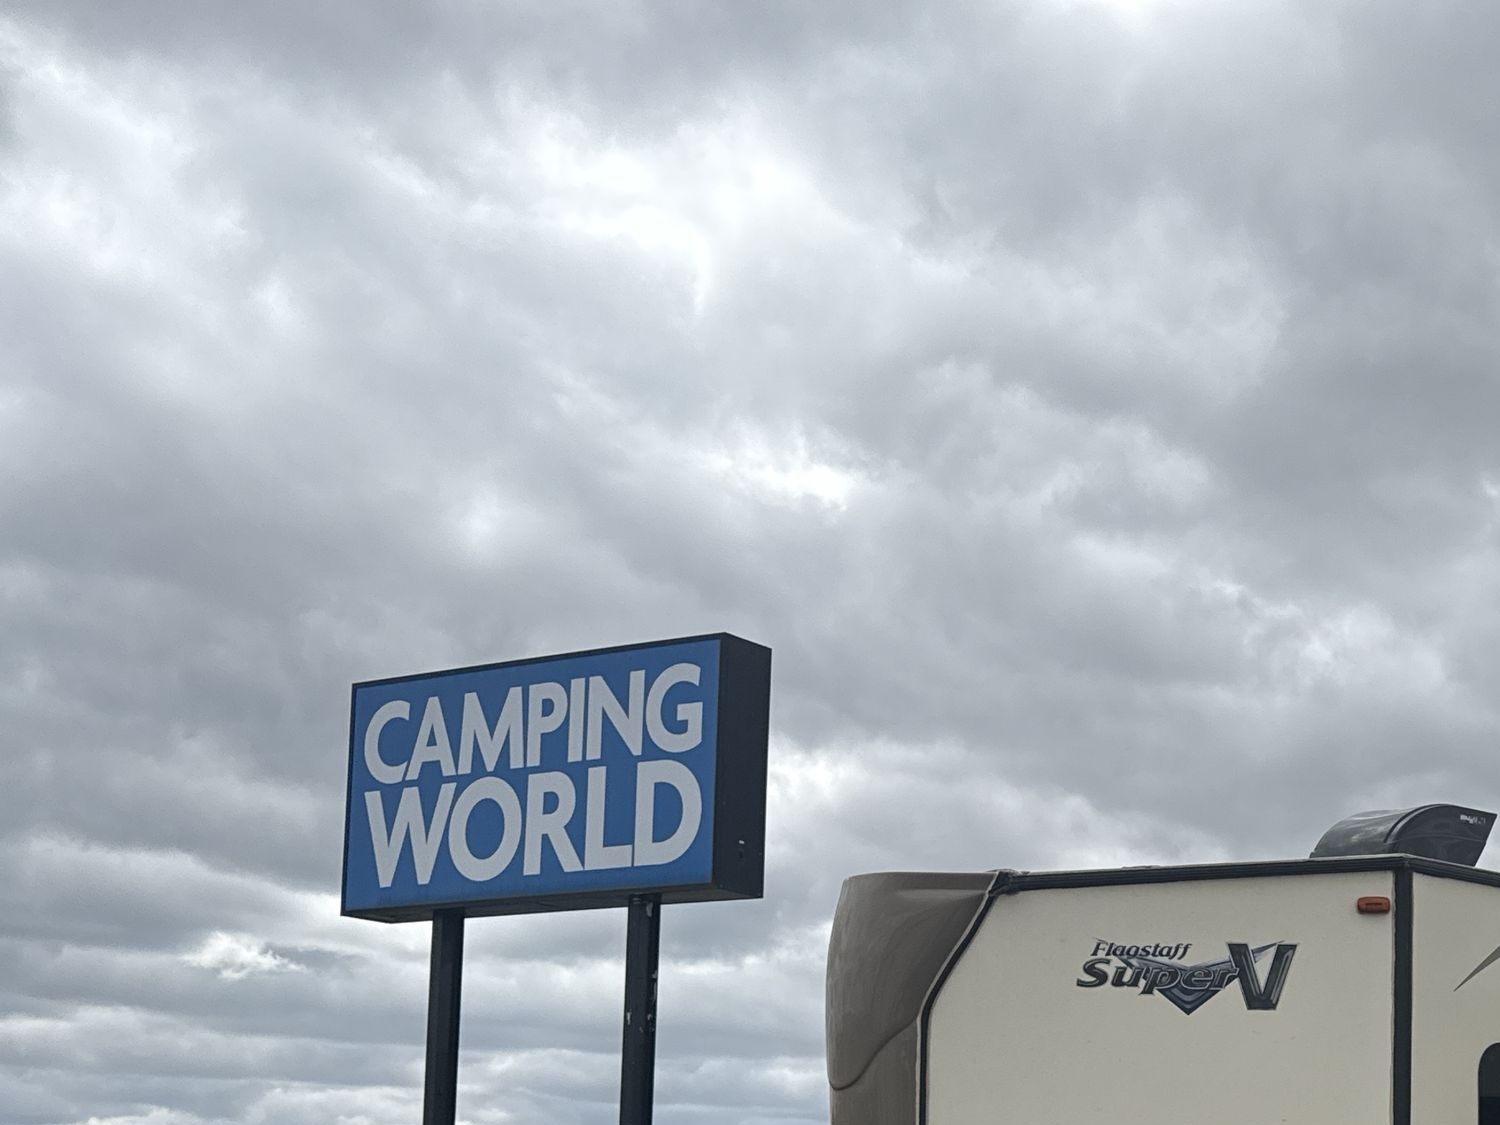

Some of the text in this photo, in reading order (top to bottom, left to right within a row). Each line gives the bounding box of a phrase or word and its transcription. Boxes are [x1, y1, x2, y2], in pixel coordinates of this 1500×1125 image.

[364, 663, 703, 785] CAMPING
[364, 760, 702, 888] WORLD
[1076, 941, 1298, 1010] Super V
[1091, 938, 1193, 960] Flagstaff
